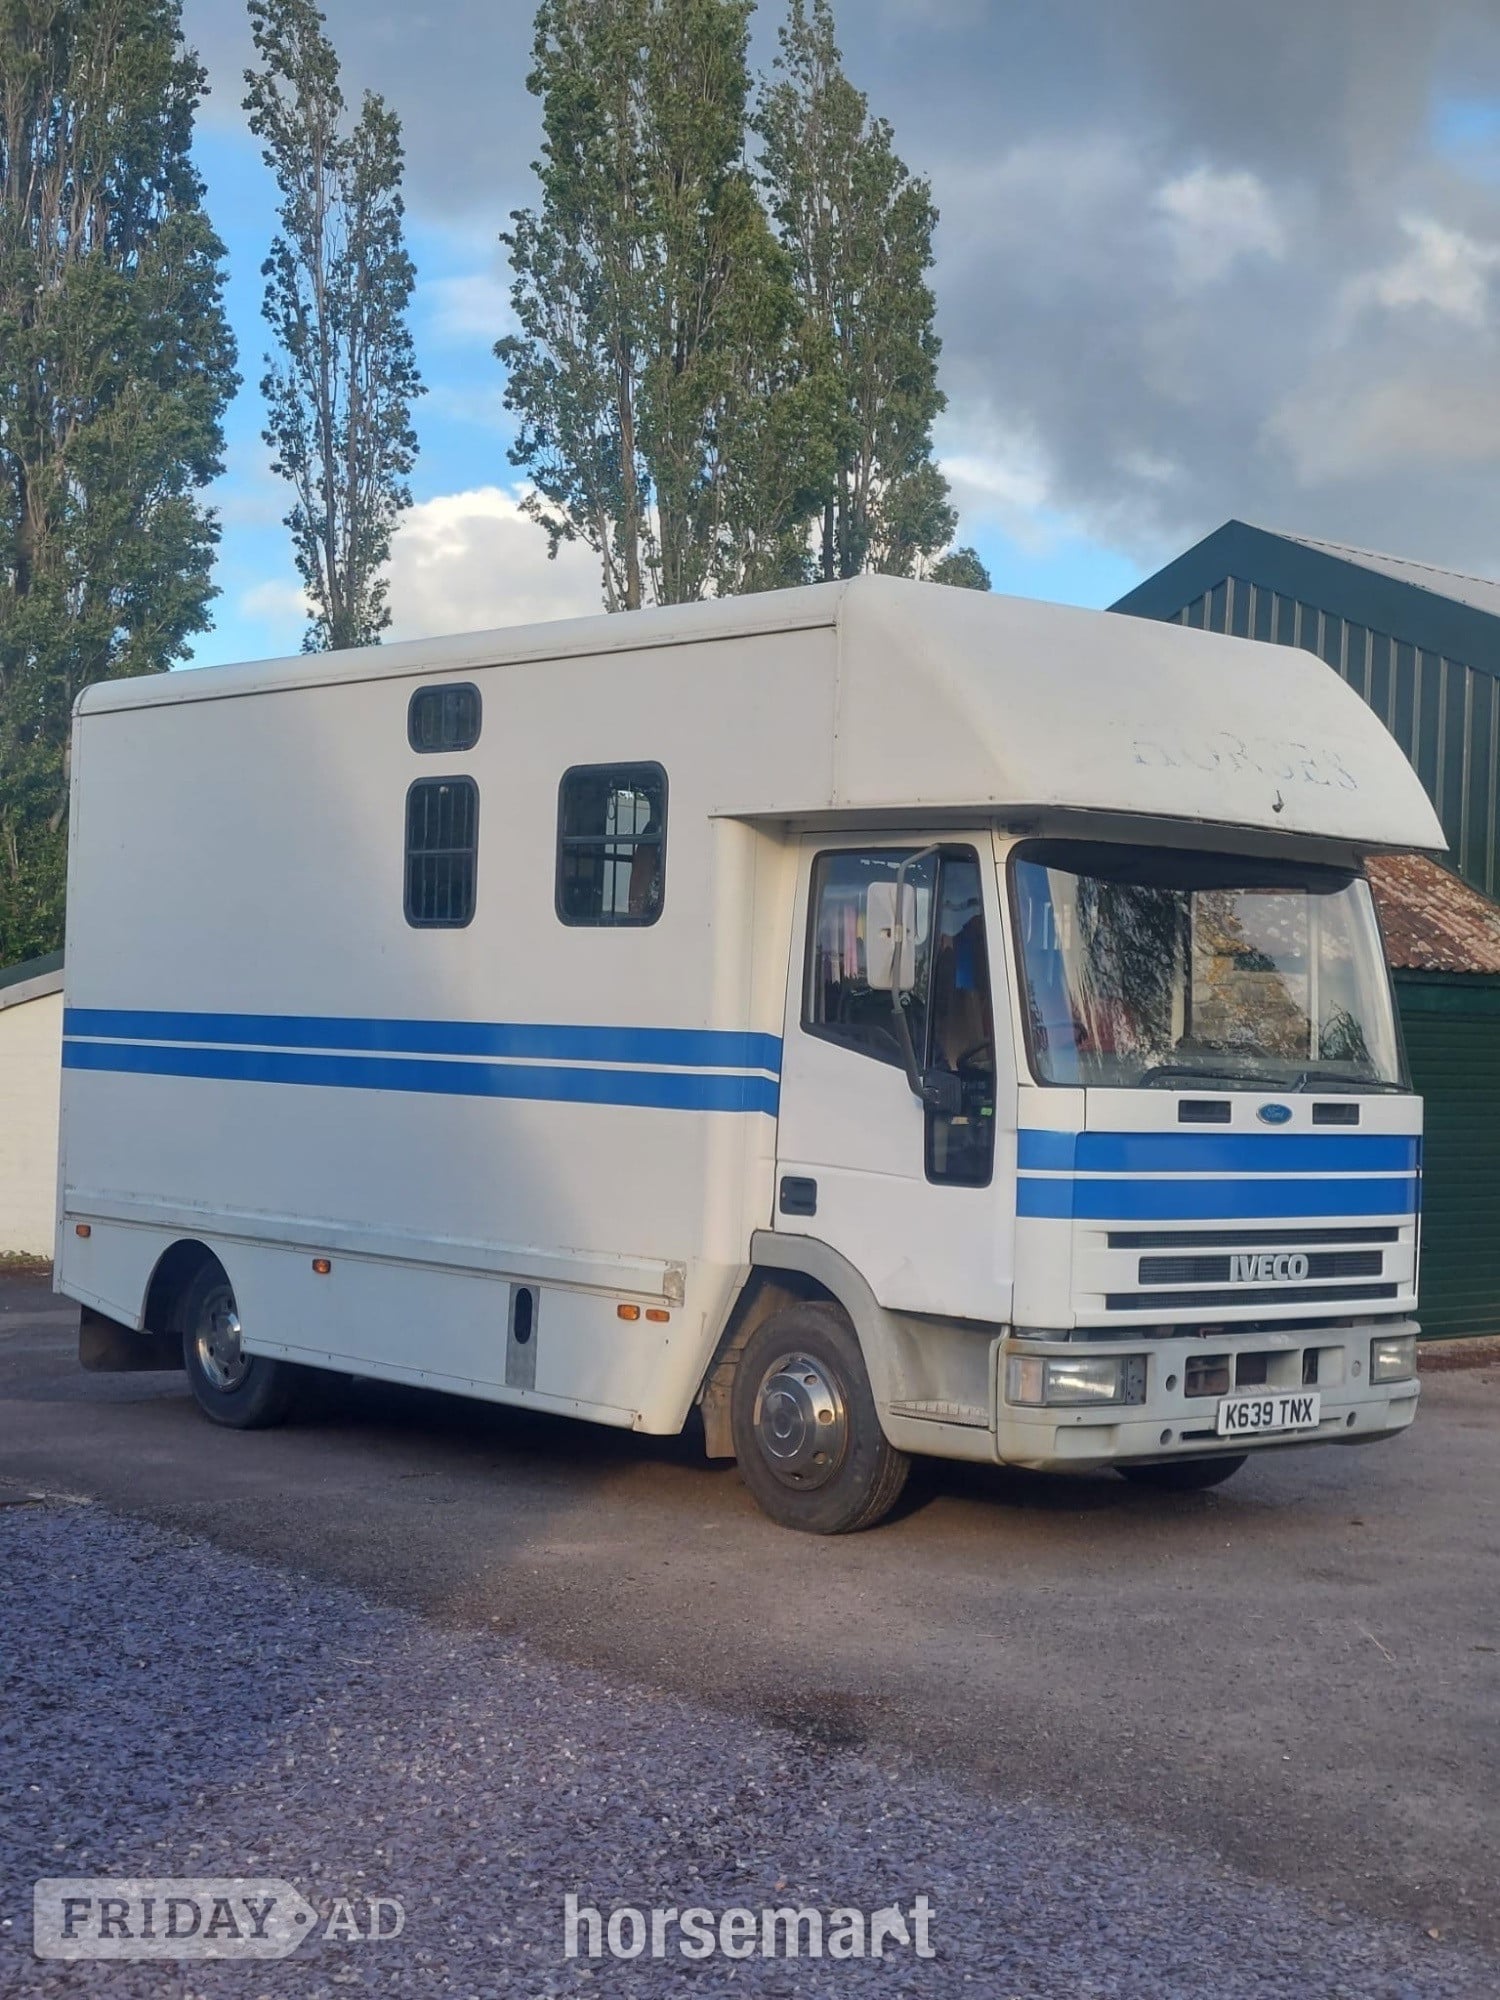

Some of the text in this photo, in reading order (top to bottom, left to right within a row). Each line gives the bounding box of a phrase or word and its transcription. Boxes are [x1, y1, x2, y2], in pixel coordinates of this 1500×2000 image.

[1229, 1254, 1309, 1282] IVECO
[1225, 1398, 1313, 1429] K639 TNX
